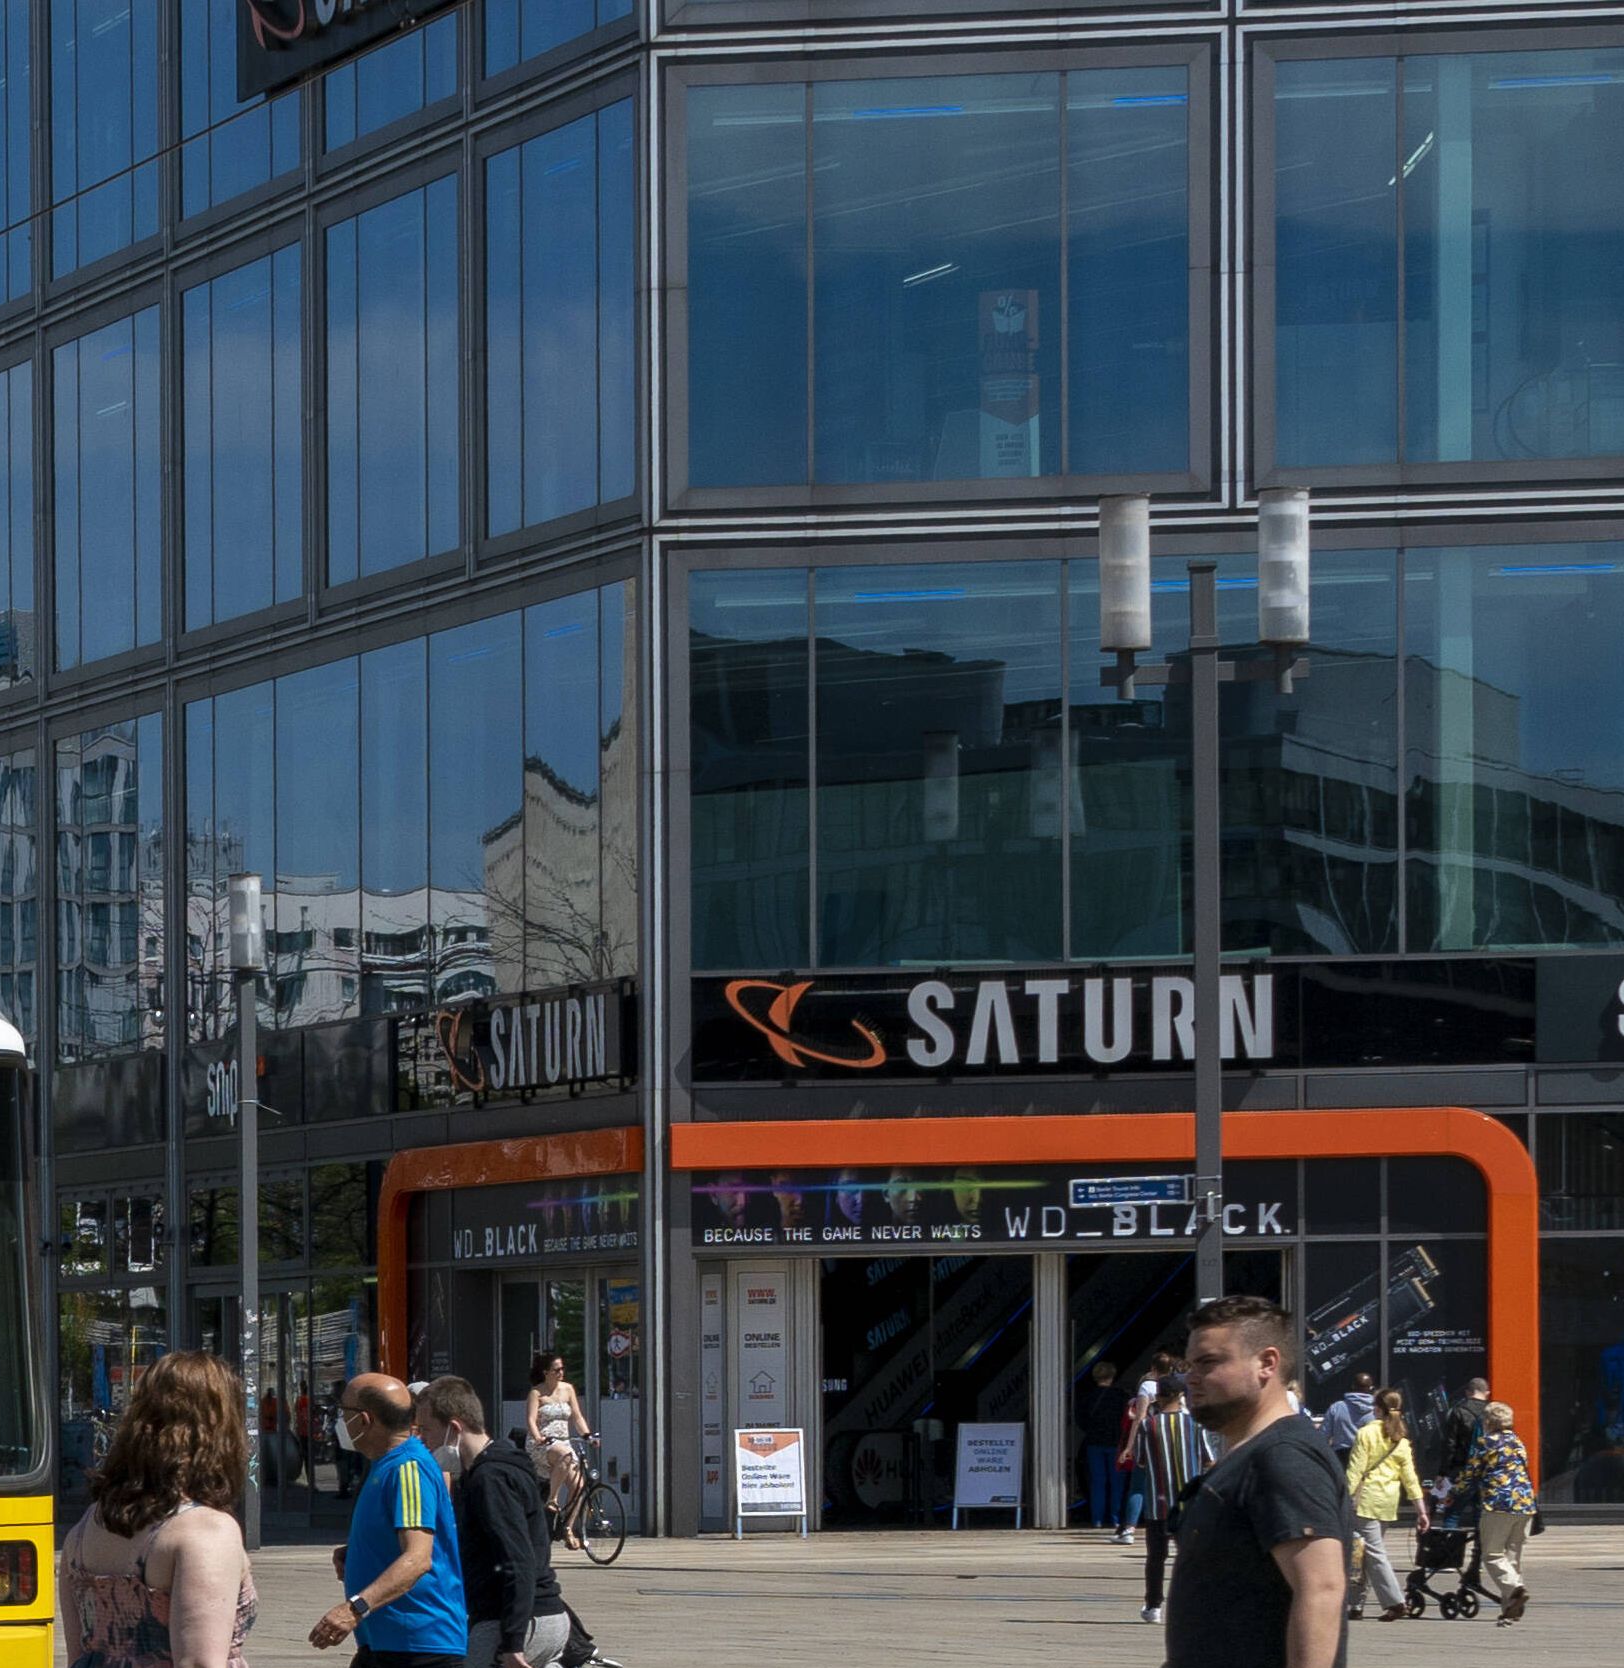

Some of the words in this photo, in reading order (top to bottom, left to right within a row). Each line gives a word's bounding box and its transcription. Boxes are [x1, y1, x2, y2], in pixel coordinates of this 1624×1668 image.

[906, 974, 1274, 1067] SATURN
[489, 992, 605, 1091] SATURN
[453, 1223, 538, 1259] WD_BLACK
[704, 1228, 773, 1243] BECAUSE
[783, 1227, 813, 1241] THE
[822, 1226, 862, 1241] GAME
[872, 1225, 923, 1240] NEVER
[931, 1224, 982, 1239] WAITS
[744, 1333, 781, 1342] ONLINE
[1311, 1315, 1369, 1356] WD_BLACK
